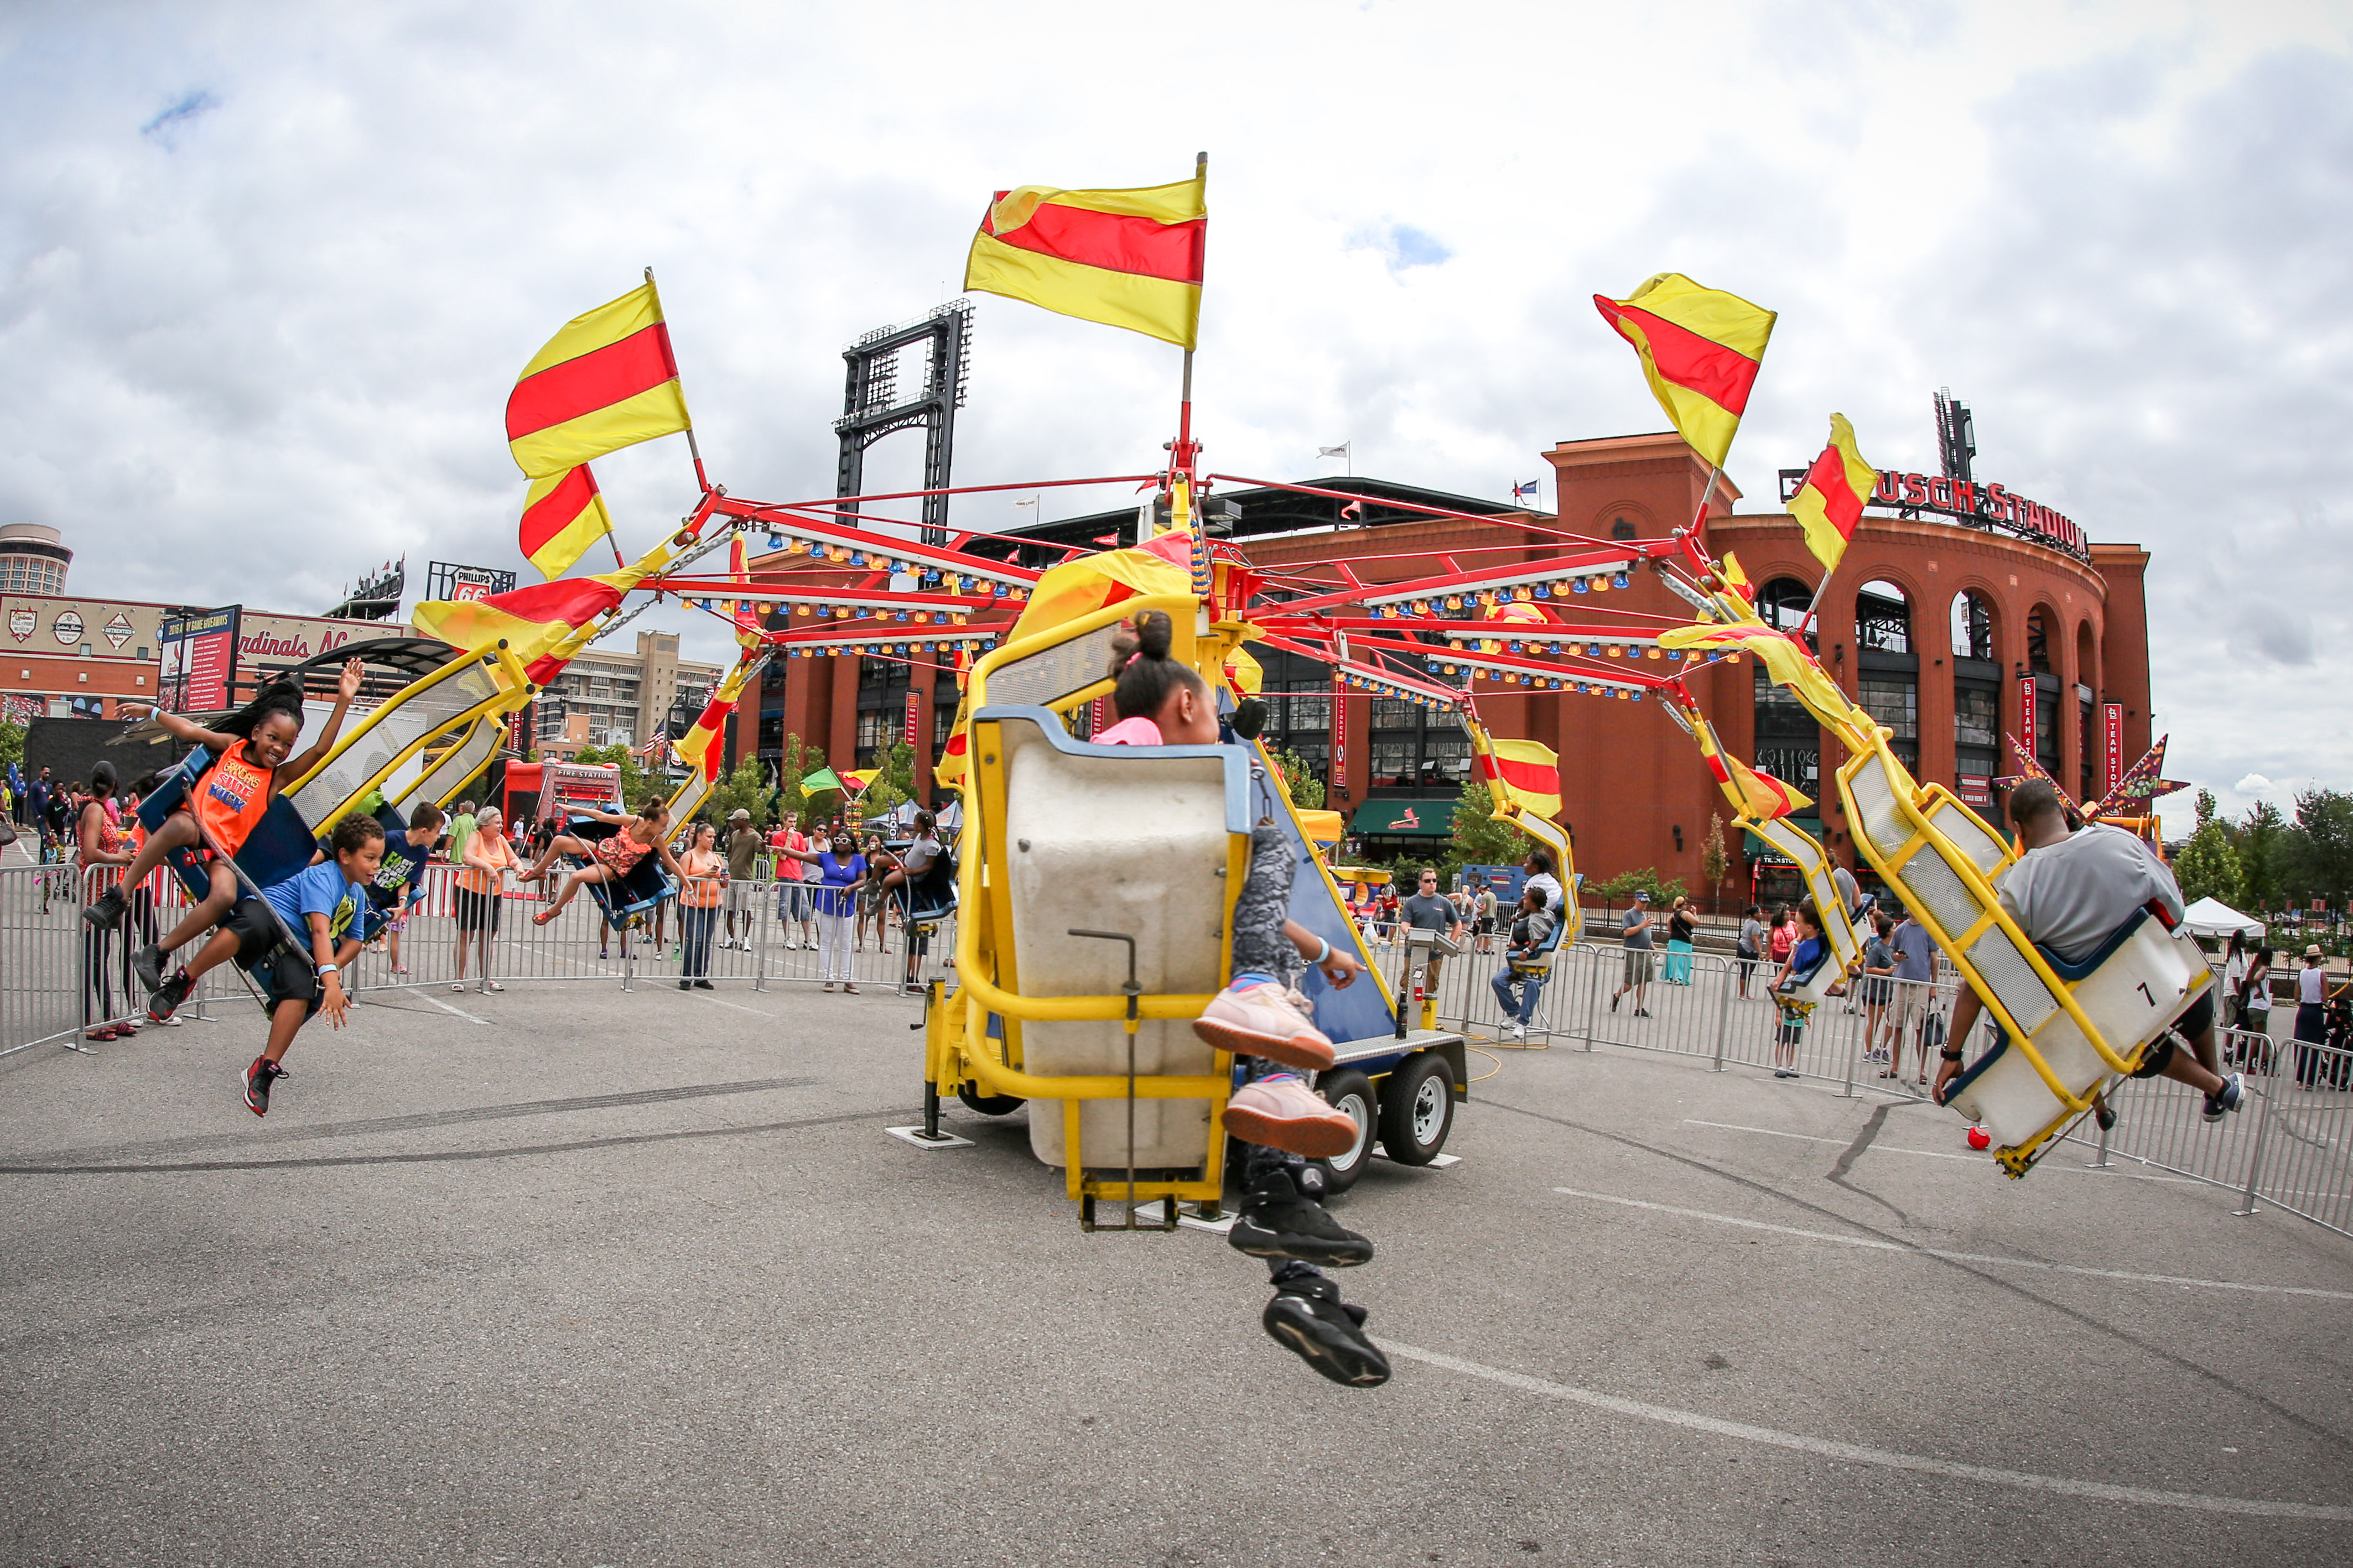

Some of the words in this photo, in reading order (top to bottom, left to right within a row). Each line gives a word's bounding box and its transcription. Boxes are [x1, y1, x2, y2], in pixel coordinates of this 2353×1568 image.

[1876, 470, 1975, 513] USCH
[1986, 482, 2088, 553] STADIUM
[458, 572, 490, 584] PHILLIPS
[169, 623, 179, 635] 2016
[204, 614, 228, 629] GIVEAWAYS
[237, 630, 311, 659] rdinals
[215, 772, 254, 798] SIDE
[578, 771, 613, 779] STATION
[208, 782, 247, 813] KICK
[2136, 981, 2156, 1007] 7
